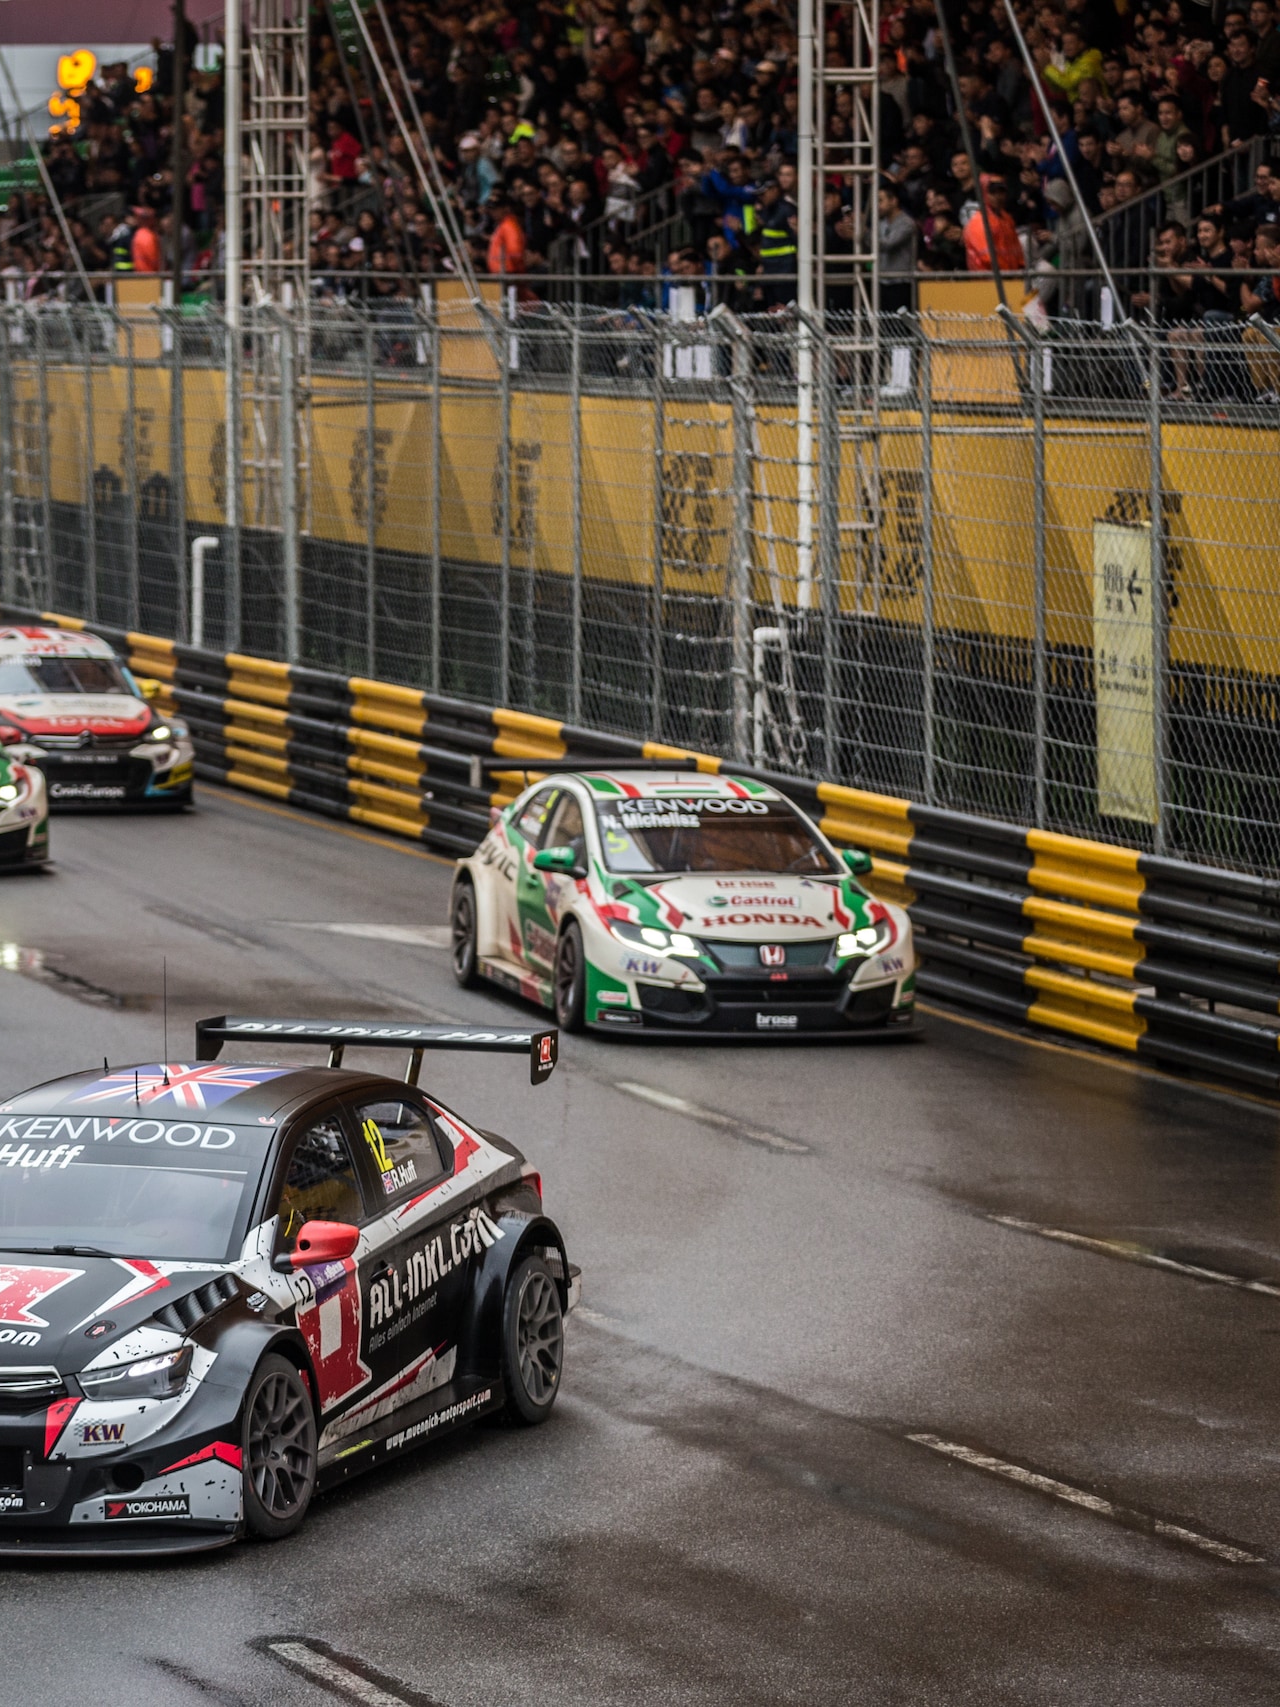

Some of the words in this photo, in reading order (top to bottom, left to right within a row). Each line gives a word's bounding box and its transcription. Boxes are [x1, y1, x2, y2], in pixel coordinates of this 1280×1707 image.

[617, 799, 769, 814] KENWOOD
[606, 831, 629, 854] 5
[731, 894, 796, 906] Castrol
[702, 913, 825, 929] HONDA
[625, 959, 662, 975] KW
[756, 1011, 798, 1025] brose
[361, 1118, 394, 1174] 12
[386, 1387, 492, 1450] www.muennich-motorsport.com
[83, 1423, 126, 1442] KW
[126, 1499, 187, 1514] YOKOHAMA
